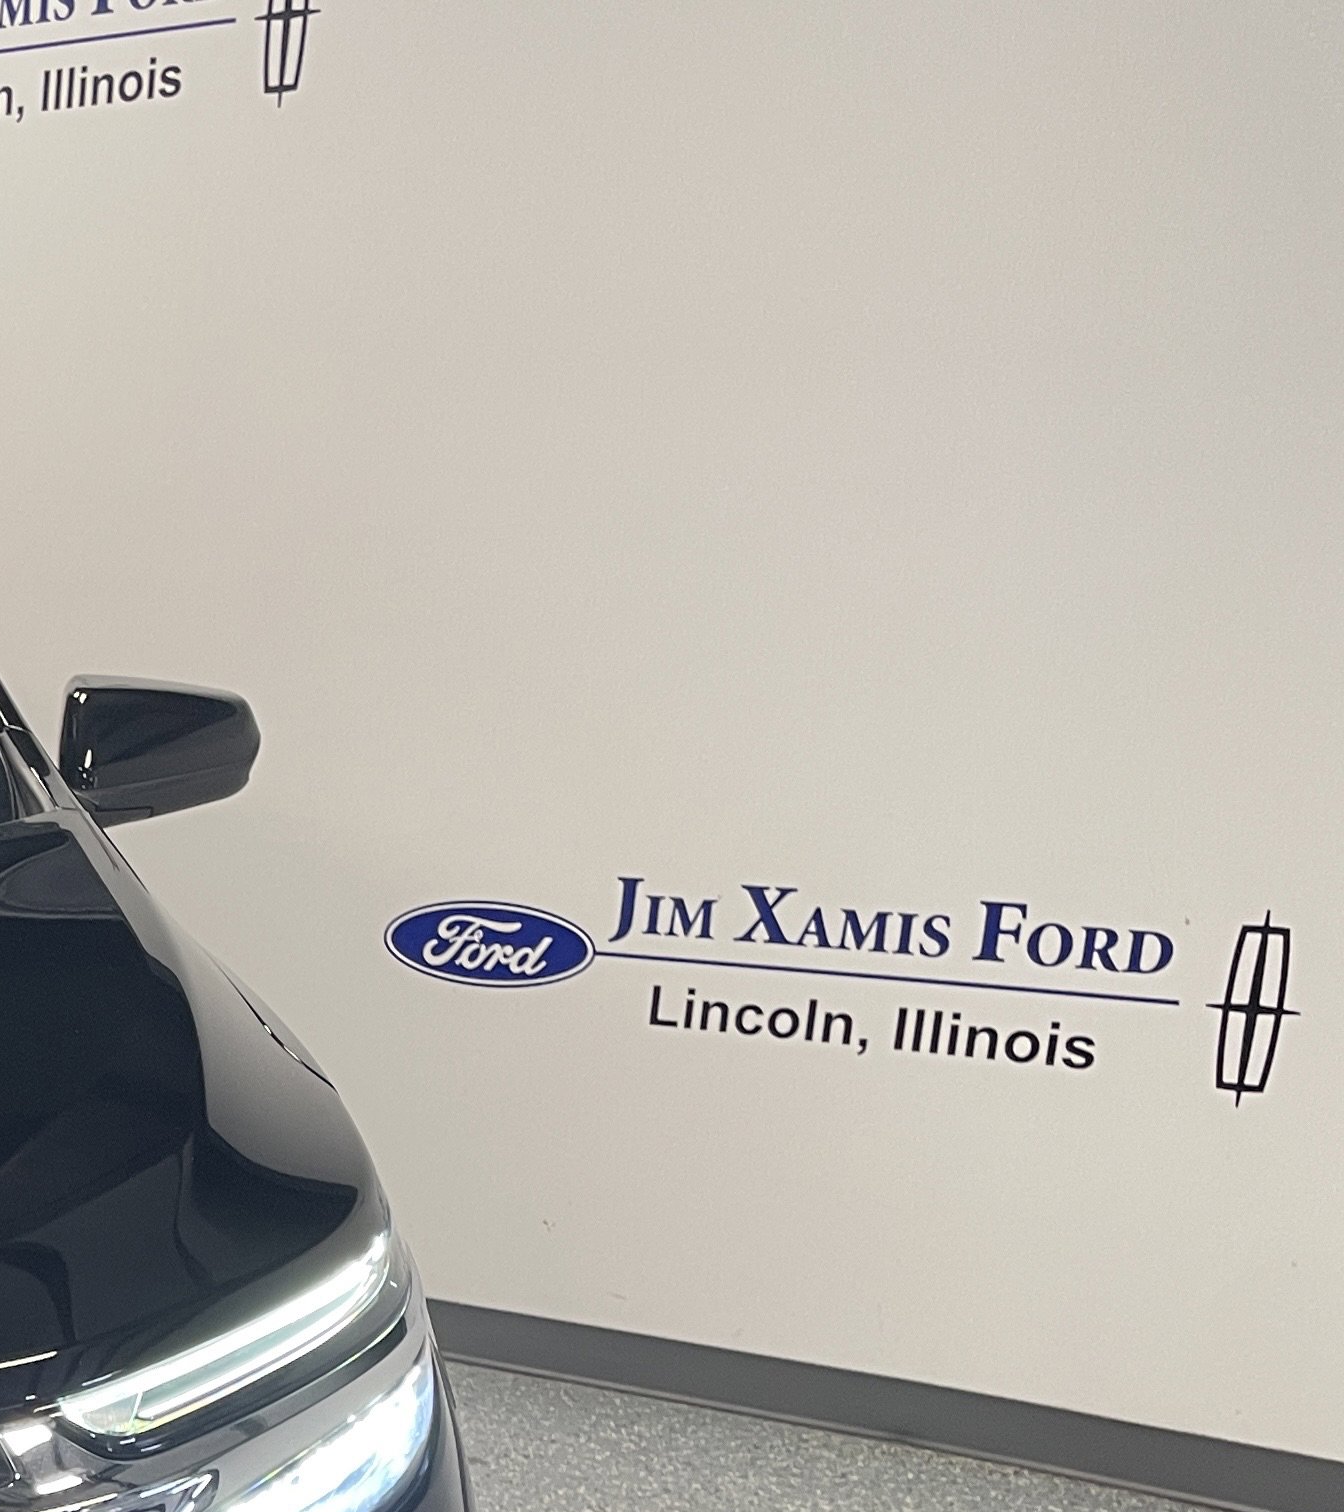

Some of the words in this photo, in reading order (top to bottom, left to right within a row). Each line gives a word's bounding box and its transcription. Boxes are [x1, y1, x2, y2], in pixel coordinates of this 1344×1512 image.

[41, 57, 183, 112] Illinois
[422, 914, 548, 975] Ford
[607, 876, 719, 943] JIM
[733, 884, 952, 958] XAMIS
[972, 900, 1175, 974] FORD
[649, 985, 869, 1056] Lincoln,
[893, 1007, 1097, 1070] Illinois
